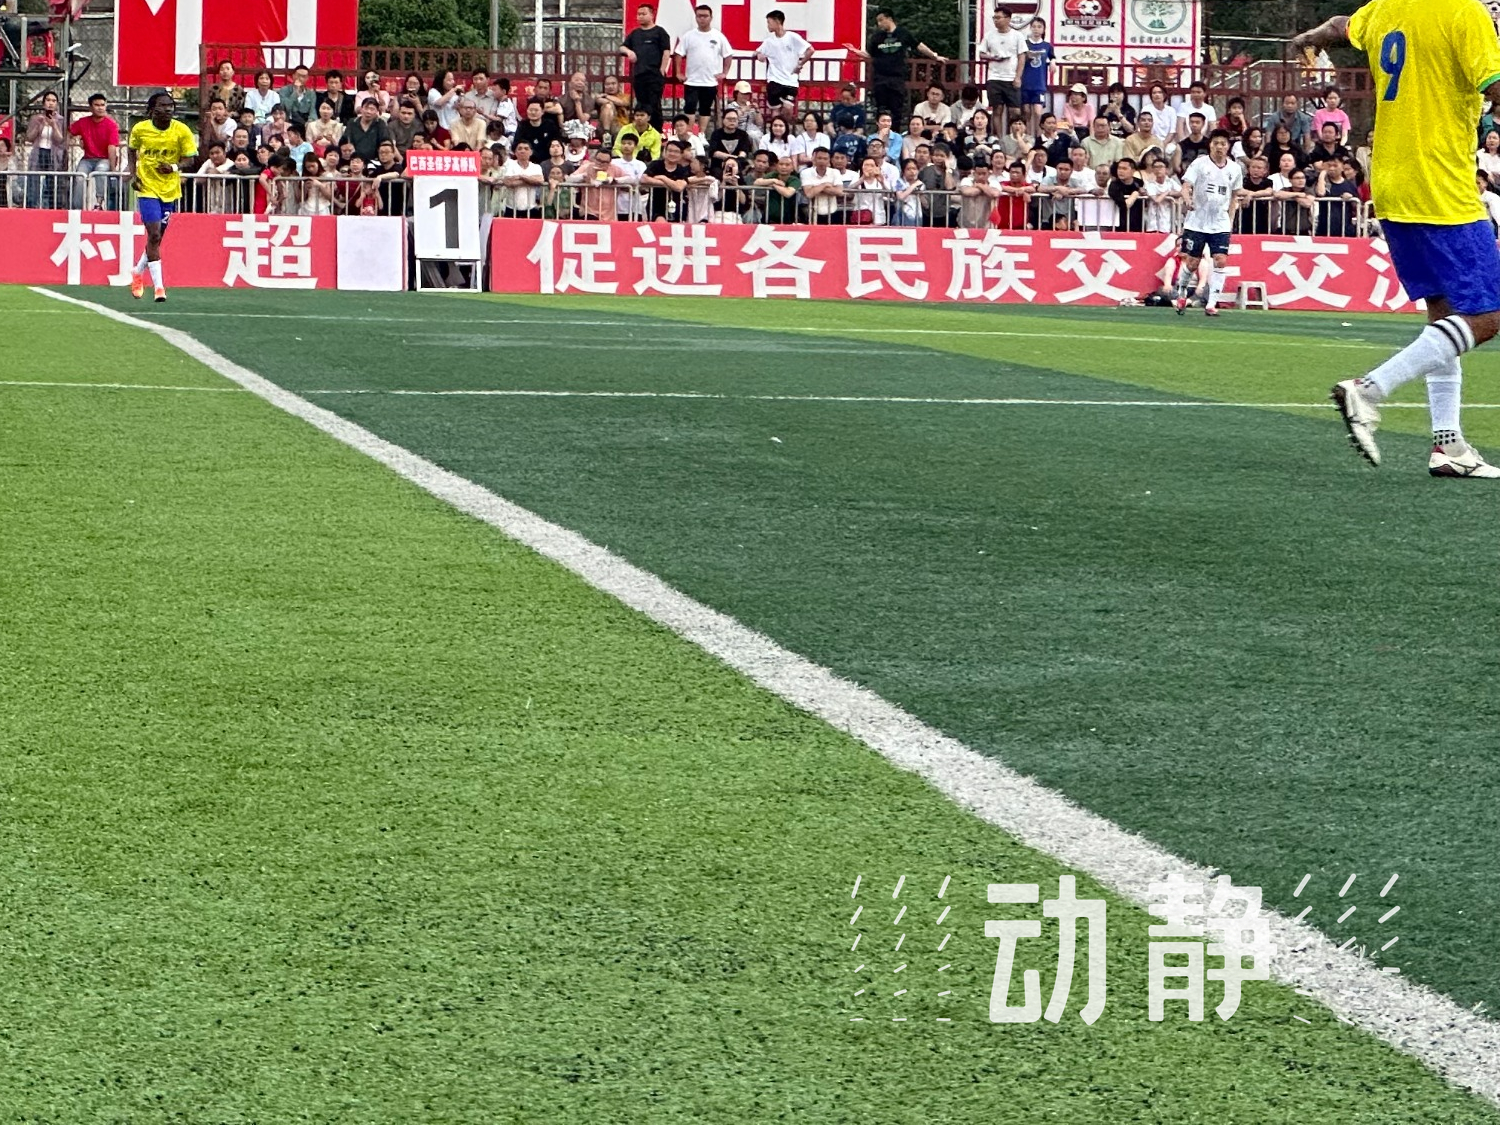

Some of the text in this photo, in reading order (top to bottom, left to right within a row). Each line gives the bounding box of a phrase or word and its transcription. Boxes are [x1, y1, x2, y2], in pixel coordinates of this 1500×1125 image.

[1379, 30, 1407, 101] 9
[409, 155, 477, 172] 巴西圣保罗高桥队
[429, 188, 460, 249] 1
